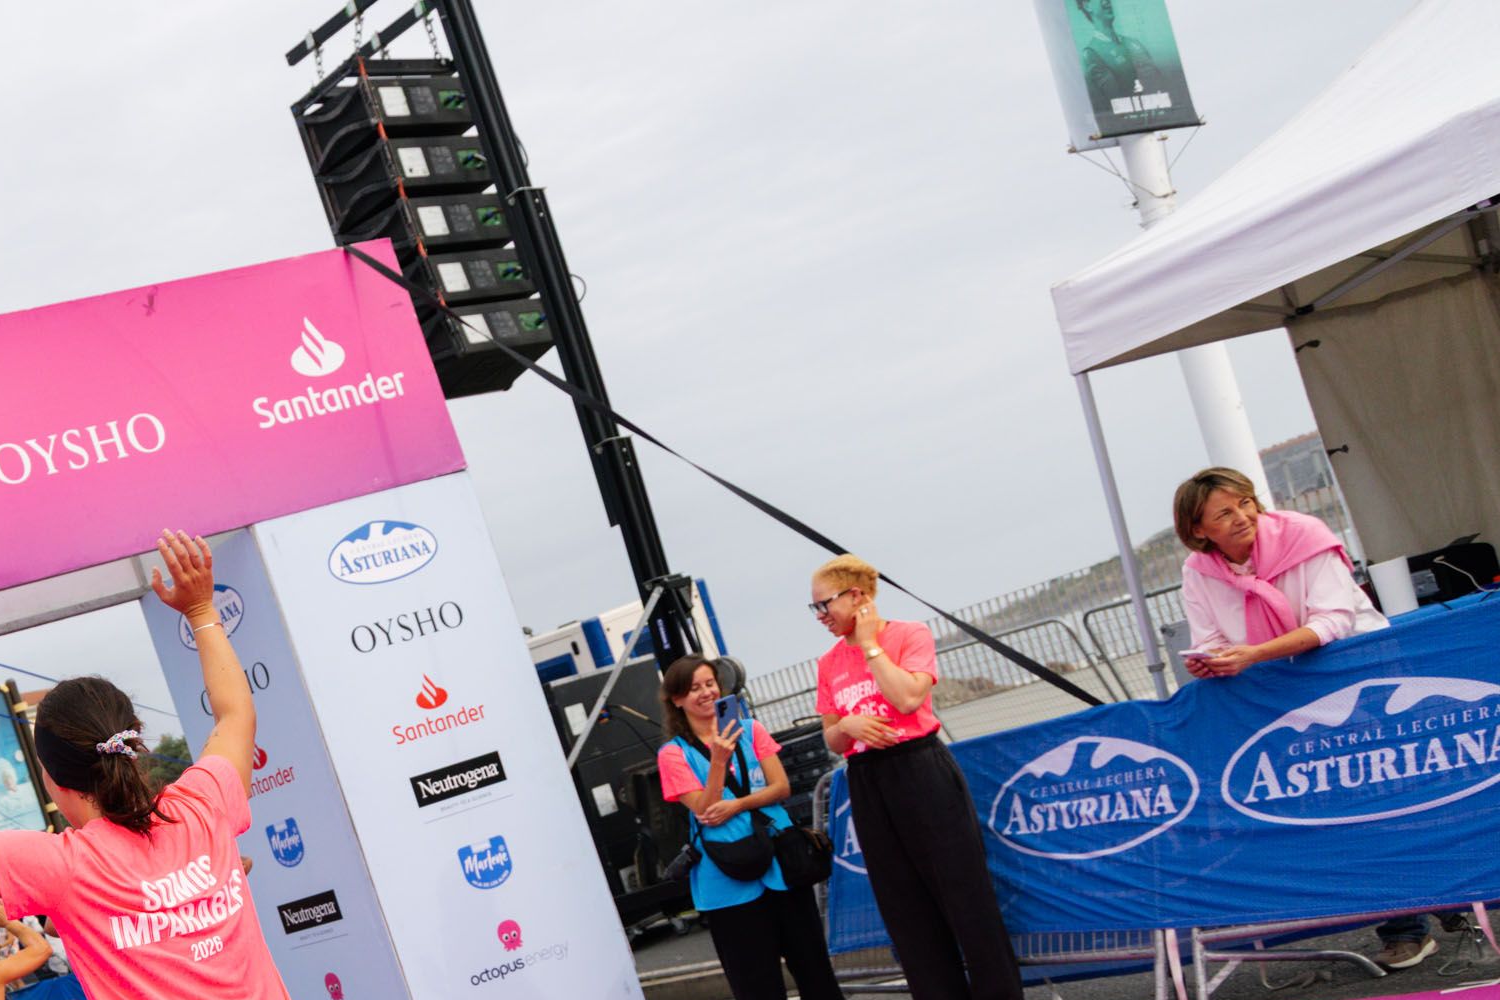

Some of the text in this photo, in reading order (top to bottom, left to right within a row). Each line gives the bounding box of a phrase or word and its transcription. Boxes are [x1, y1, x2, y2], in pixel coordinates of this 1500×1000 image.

[253, 371, 405, 428] Santander
[340, 540, 432, 577] ASTURIANA
[351, 600, 465, 655] OYSHO
[392, 704, 485, 745] Santander
[1288, 728, 1385, 757] CENTRAL
[417, 762, 500, 799] Neutrogena
[1030, 766, 1167, 798] CENTRAL LECHERA
[1002, 784, 1178, 836] ASTURIANA
[463, 849, 509, 879] Marlene
[141, 855, 217, 911] SOMOS
[282, 901, 338, 927] Neutrogena
[191, 935, 224, 962] 2026
[470, 941, 569, 986] octopus energy
